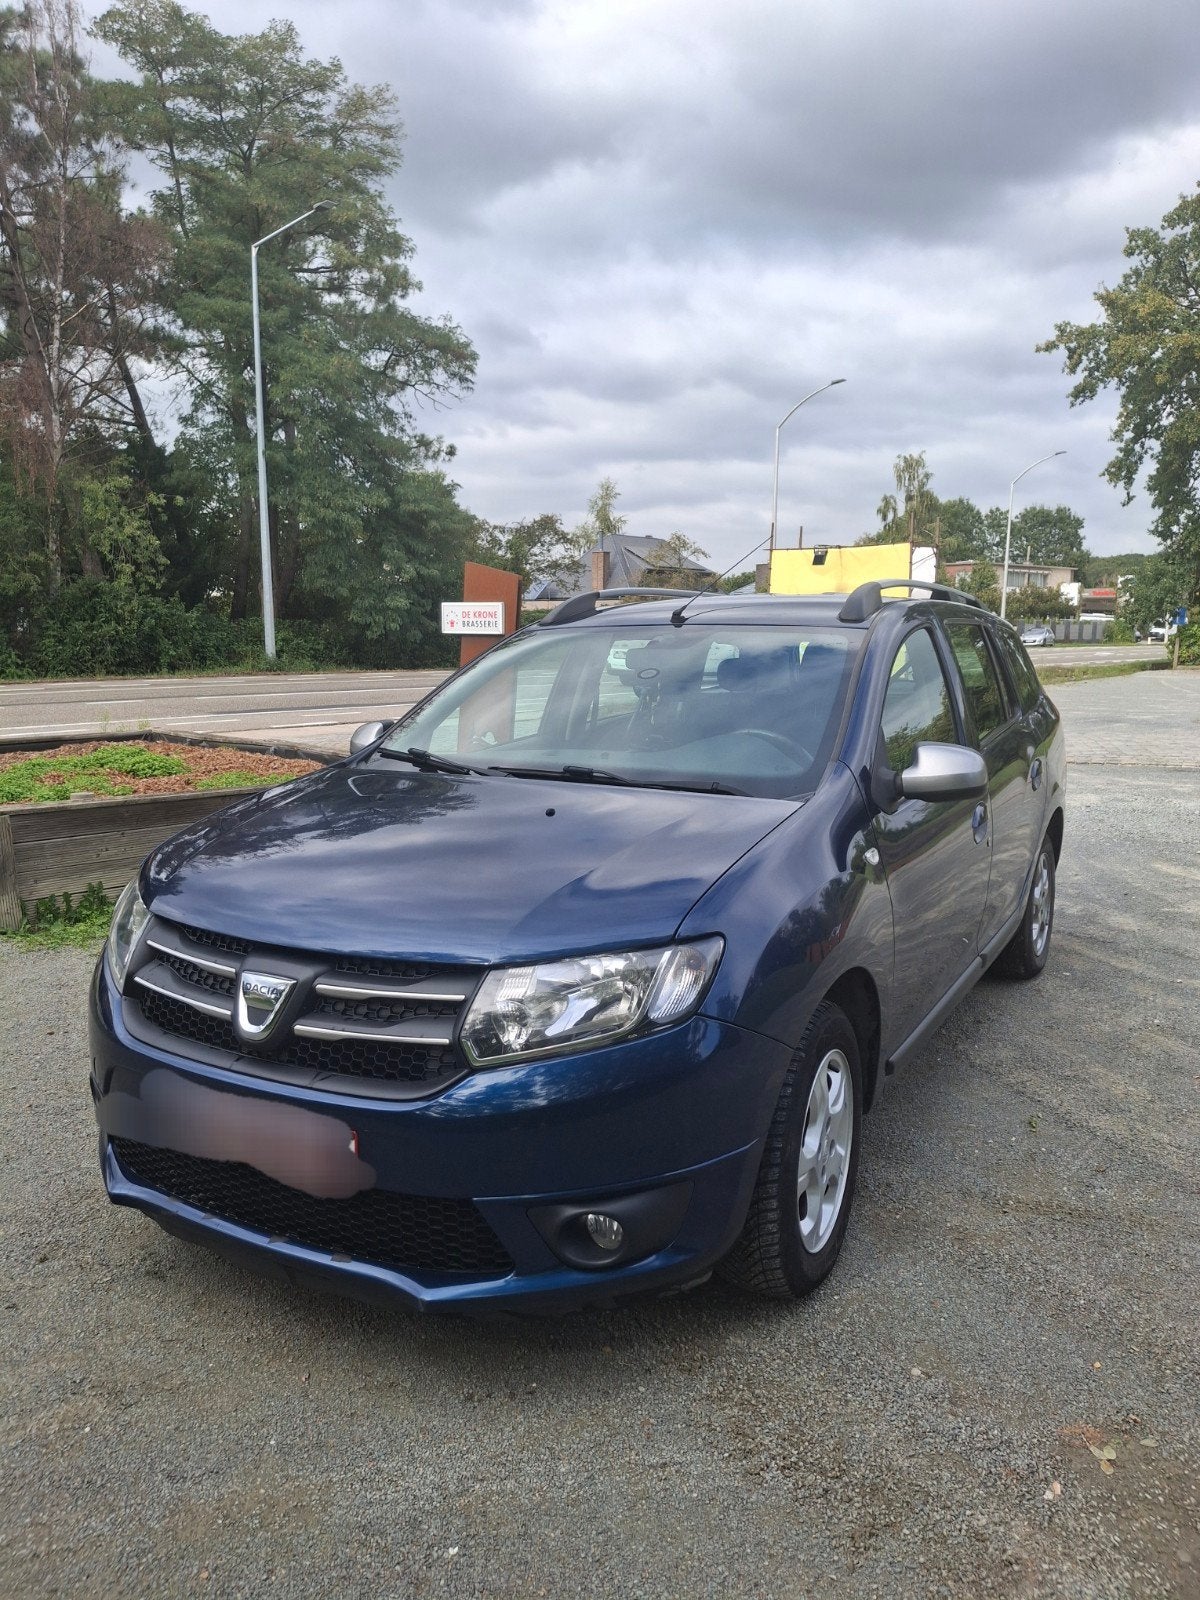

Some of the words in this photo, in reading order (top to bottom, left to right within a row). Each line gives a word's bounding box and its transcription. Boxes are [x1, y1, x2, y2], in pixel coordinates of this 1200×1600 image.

[462, 611, 471, 619] DE
[473, 611, 498, 619] KRONE
[462, 620, 498, 628] BRASSERIE
[246, 982, 280, 996] DACIA
